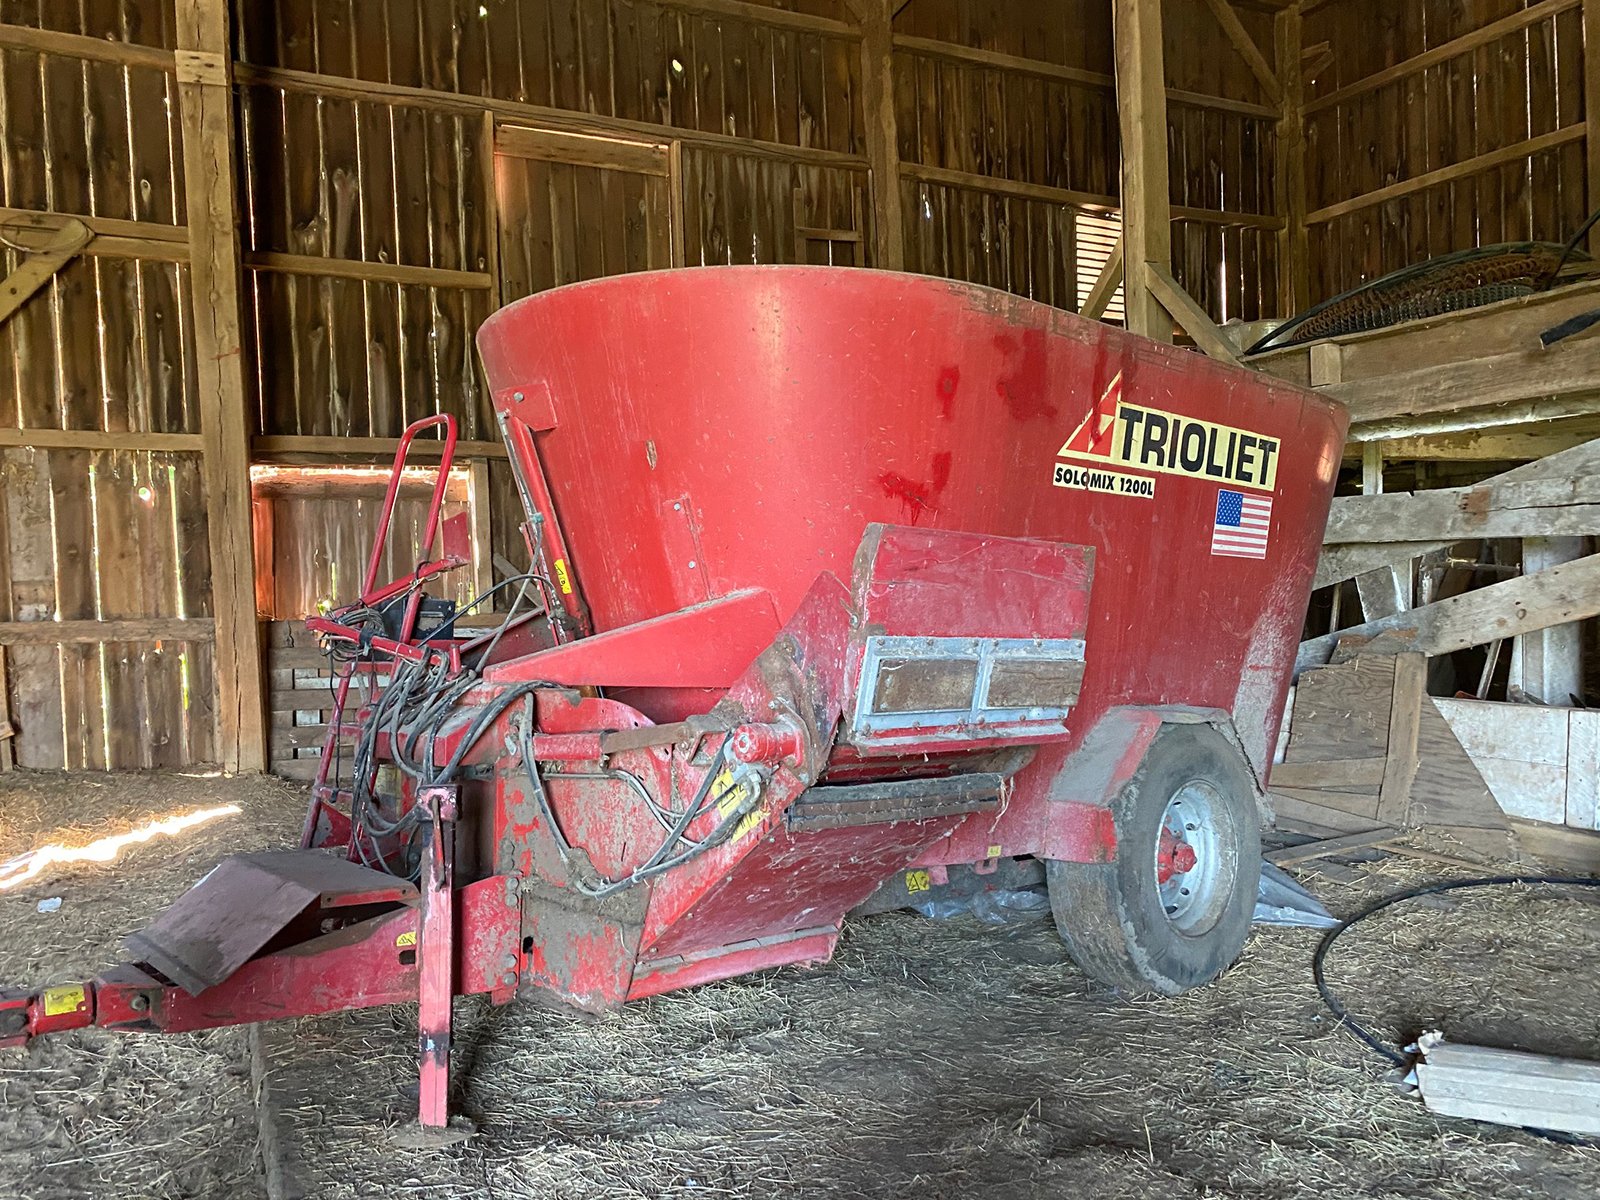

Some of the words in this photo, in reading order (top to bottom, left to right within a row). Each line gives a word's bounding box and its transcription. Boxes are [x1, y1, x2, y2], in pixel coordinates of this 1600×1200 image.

[1119, 406, 1278, 485] TRIOLIET
[1055, 467, 1115, 490] SOLOMIX
[1119, 477, 1153, 496] 1200L
